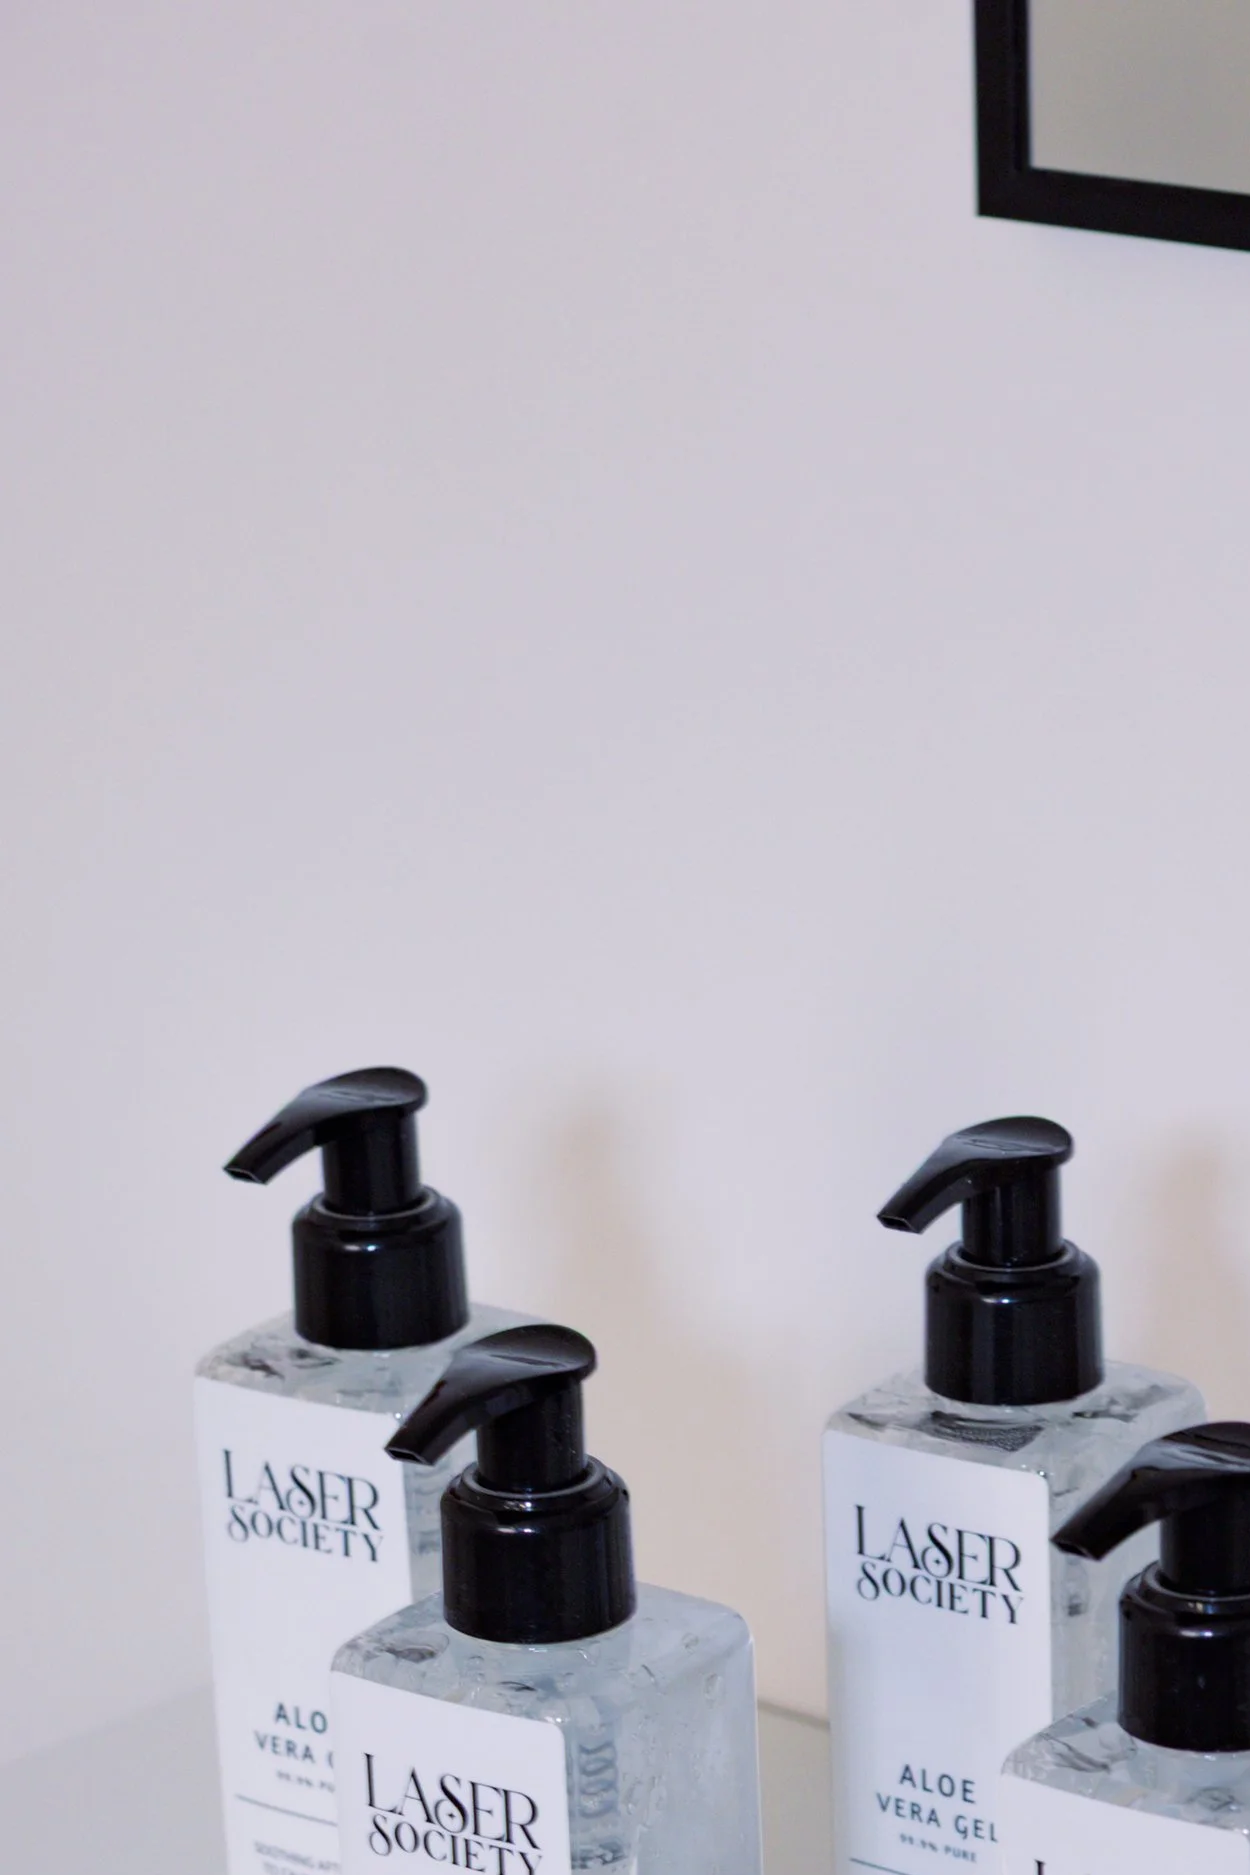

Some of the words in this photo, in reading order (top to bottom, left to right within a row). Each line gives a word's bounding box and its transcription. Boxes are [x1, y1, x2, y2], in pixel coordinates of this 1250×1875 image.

[224, 1449, 380, 1532] LASER
[228, 1506, 382, 1562] SOCIETY
[856, 1505, 1022, 1594] LASER
[857, 1562, 1023, 1624] SOCIETY
[274, 1702, 328, 1734] ALO
[255, 1731, 315, 1763] VERA
[364, 1753, 541, 1850] LASER
[899, 1764, 975, 1804] ALOE
[876, 1793, 941, 1827] VERA
[954, 1815, 998, 1843] GEL
